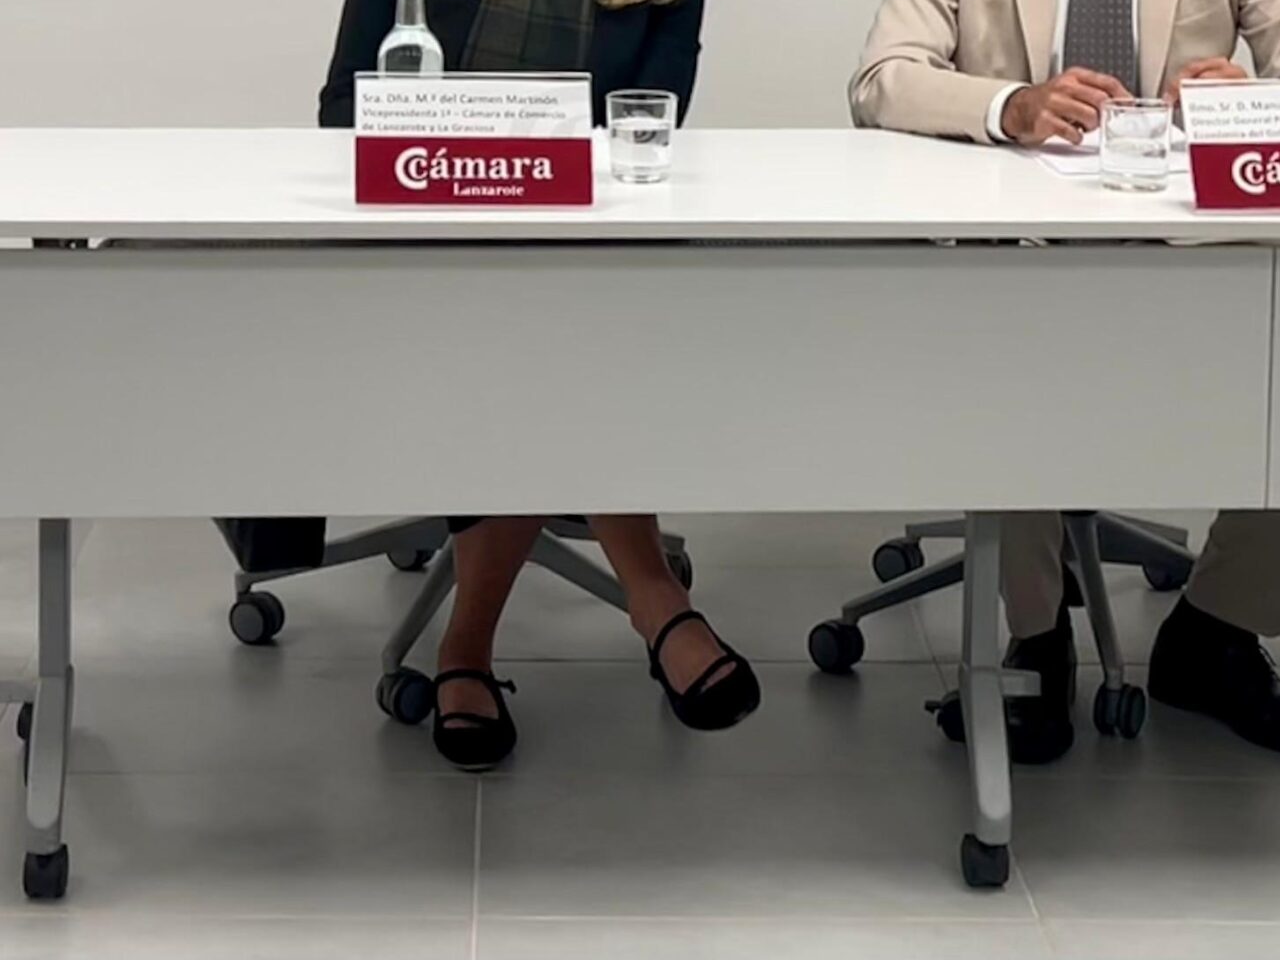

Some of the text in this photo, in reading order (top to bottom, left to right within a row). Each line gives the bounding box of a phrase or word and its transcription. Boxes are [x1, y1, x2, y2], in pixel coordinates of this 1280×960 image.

[439, 93, 457, 104] del
[459, 93, 505, 105] Carmen
[503, 109, 515, 119] de
[453, 182, 525, 197] Lanzarote
